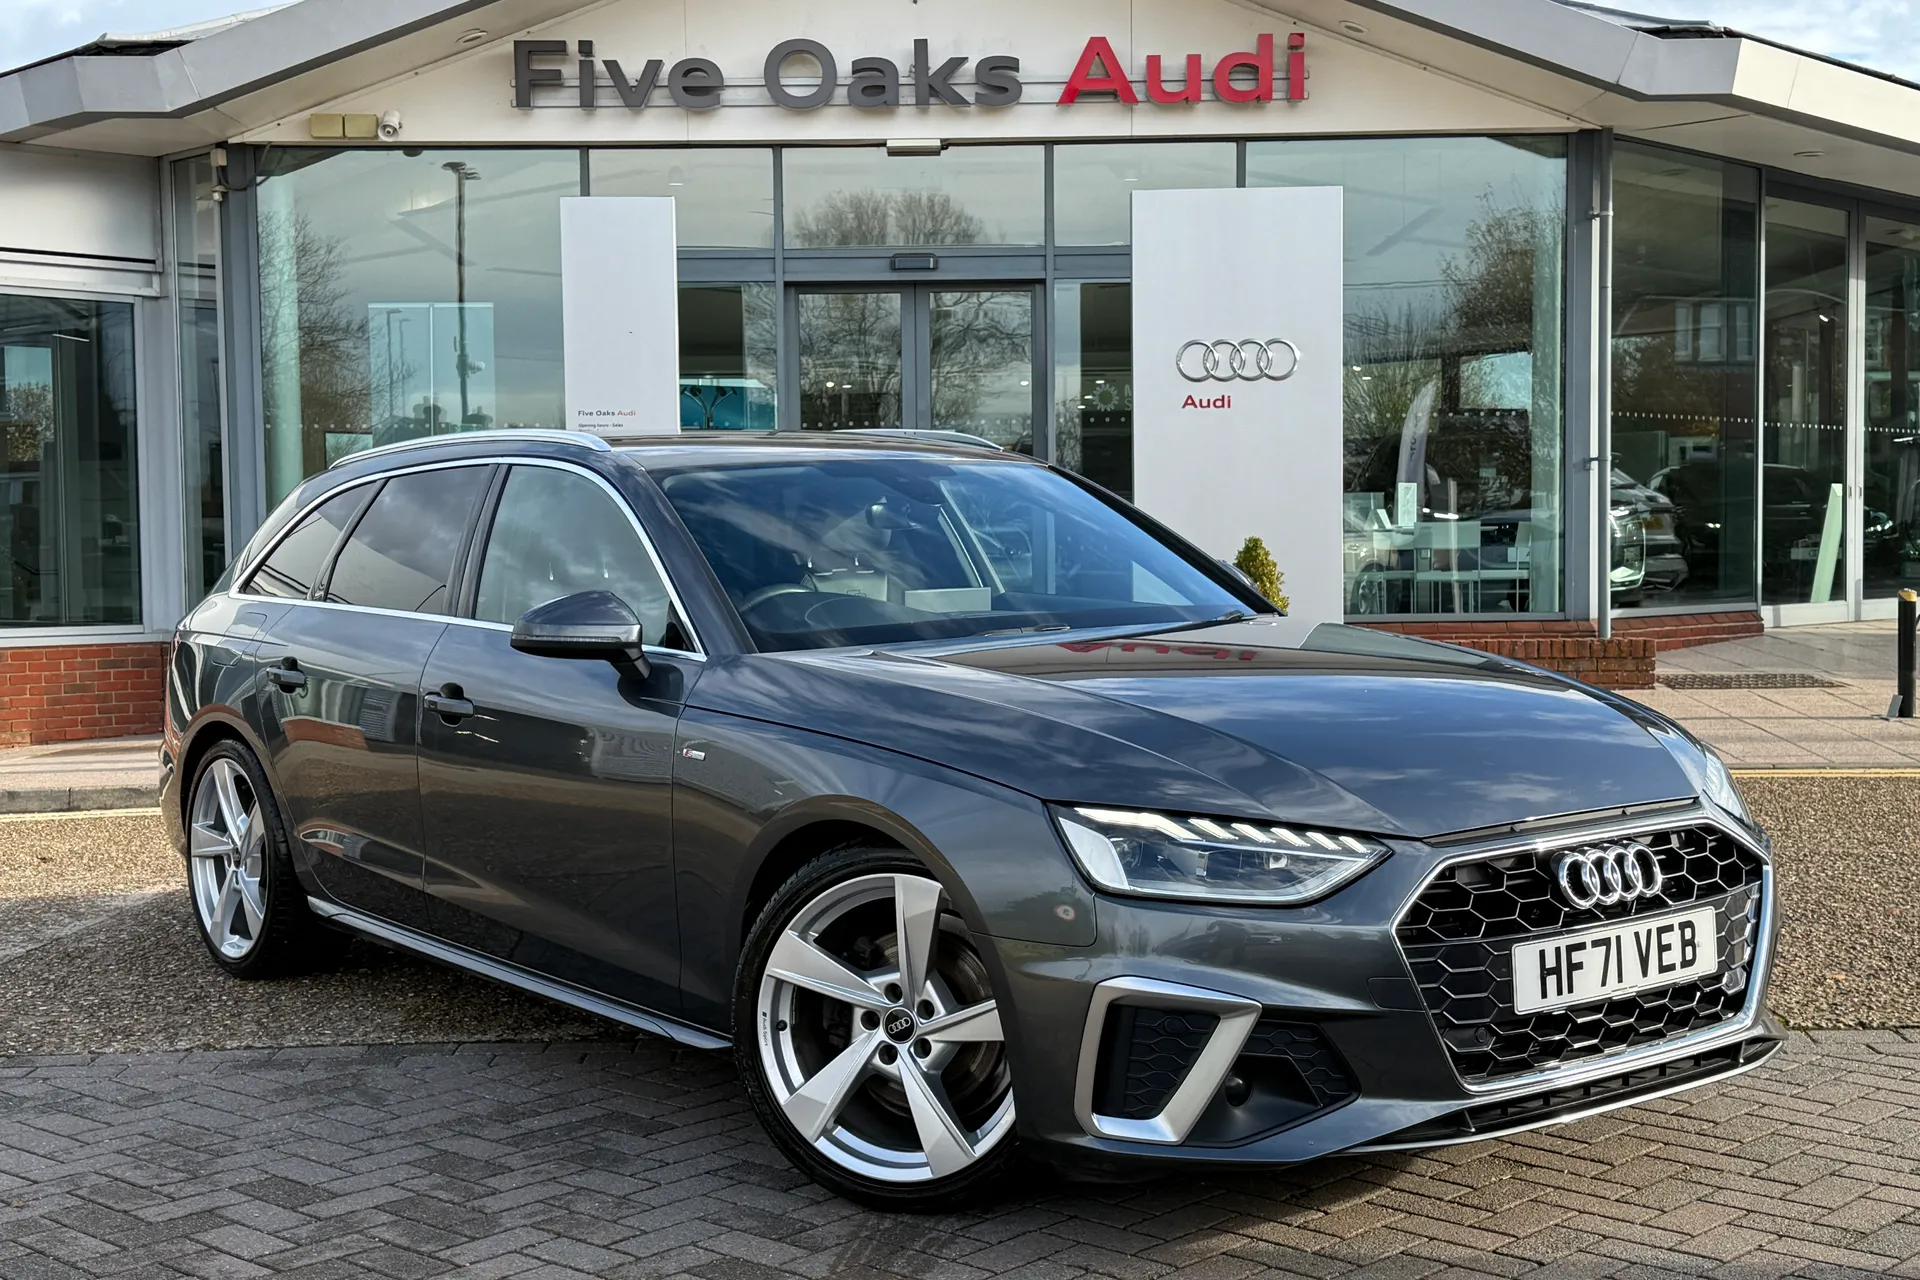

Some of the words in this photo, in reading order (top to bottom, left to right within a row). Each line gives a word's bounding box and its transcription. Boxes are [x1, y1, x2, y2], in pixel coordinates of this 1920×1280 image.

[513, 39, 725, 109] Five
[763, 38, 1023, 109] Oaks
[1056, 32, 1305, 106] Audi
[1181, 394, 1232, 409] Audi
[1538, 934, 1624, 1000] HF71
[1633, 919, 1697, 979] VEB
